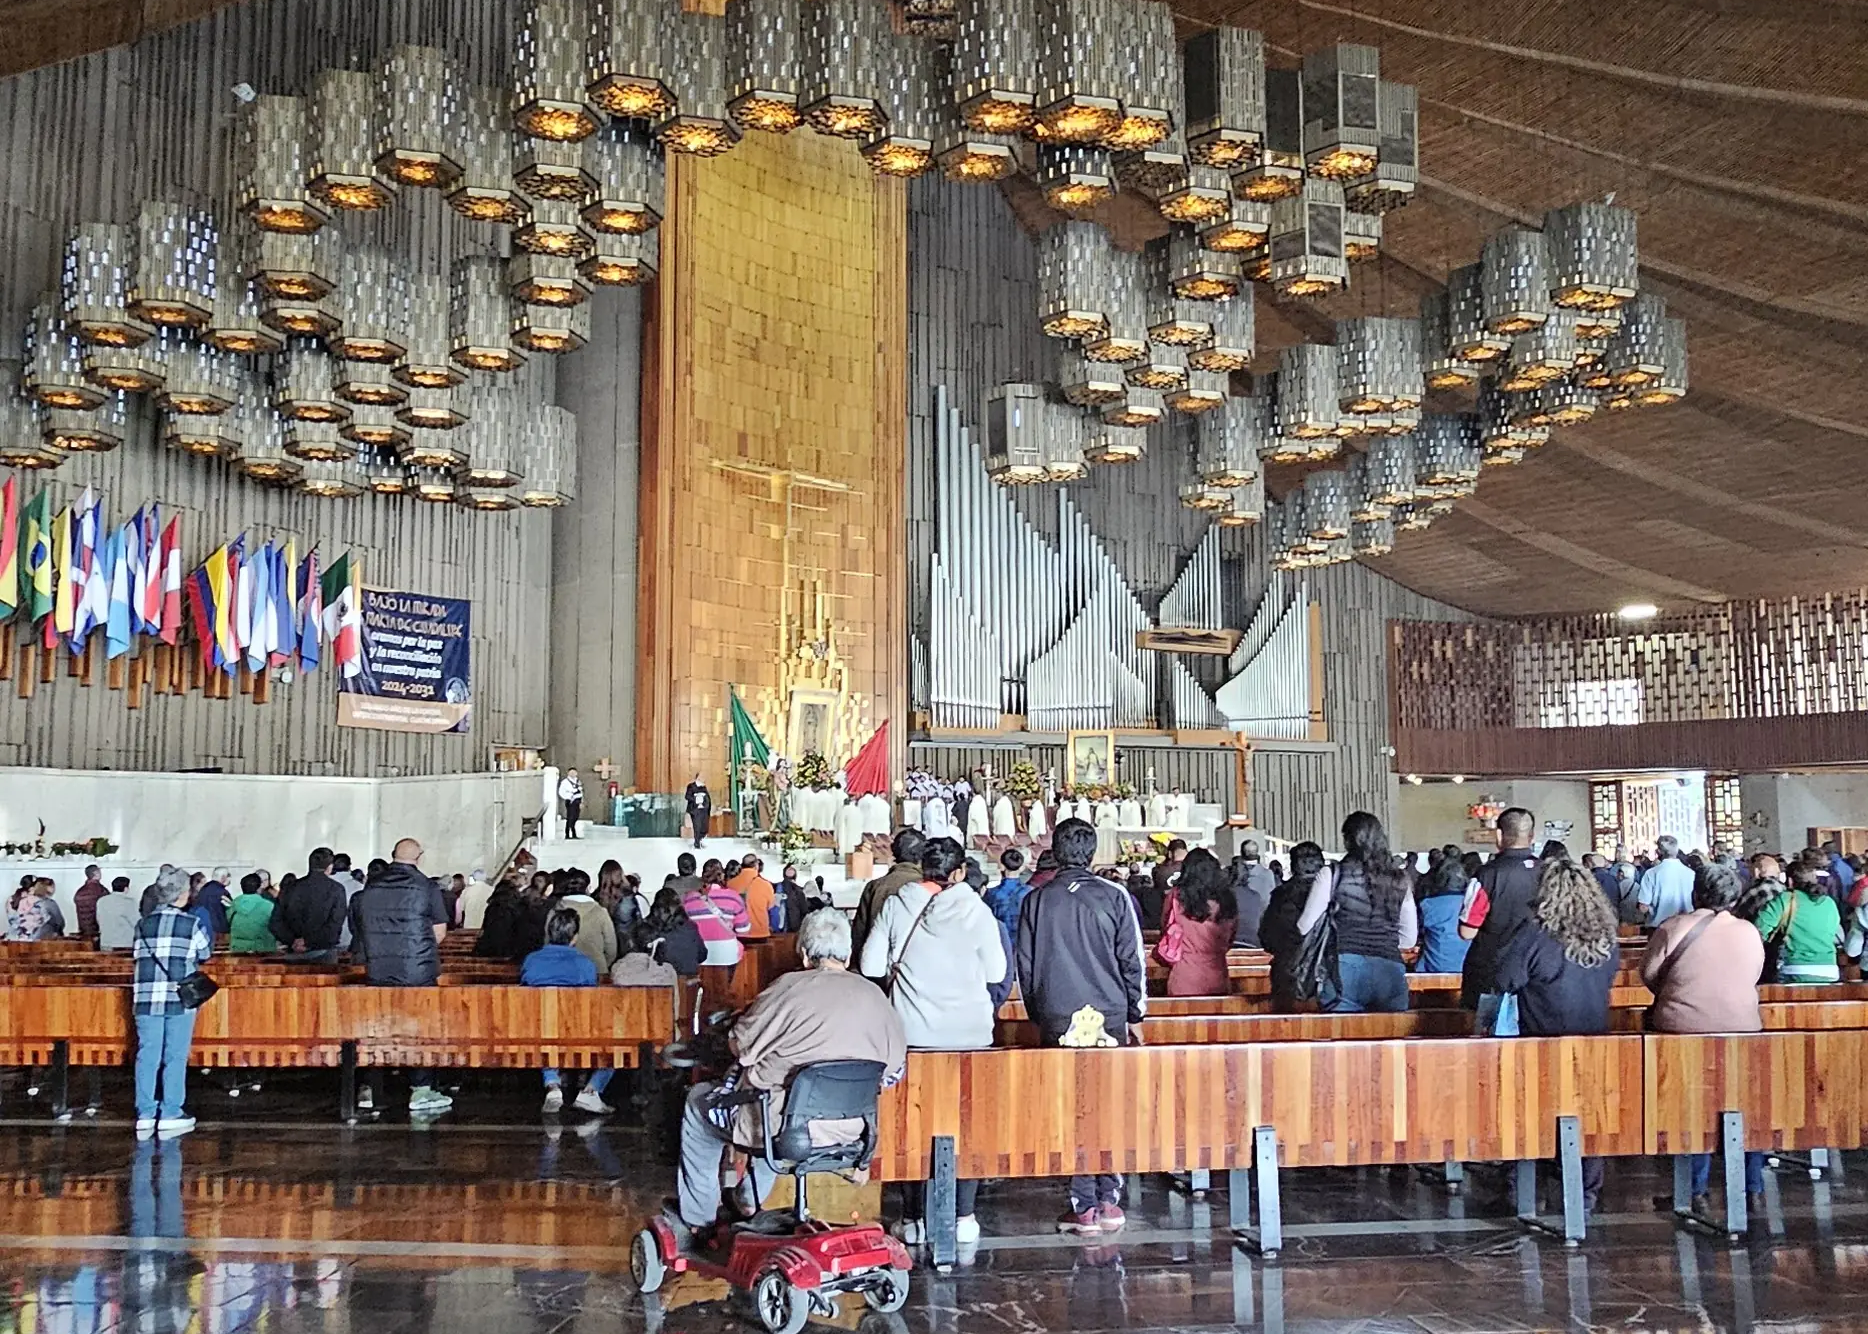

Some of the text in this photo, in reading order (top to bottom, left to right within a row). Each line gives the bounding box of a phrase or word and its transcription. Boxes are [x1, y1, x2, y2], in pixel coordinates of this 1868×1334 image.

[368, 592, 397, 611] BAJO
[399, 598, 410, 613] LA
[417, 635, 427, 648] la
[369, 646, 377, 659] y
[376, 645, 387, 658] la
